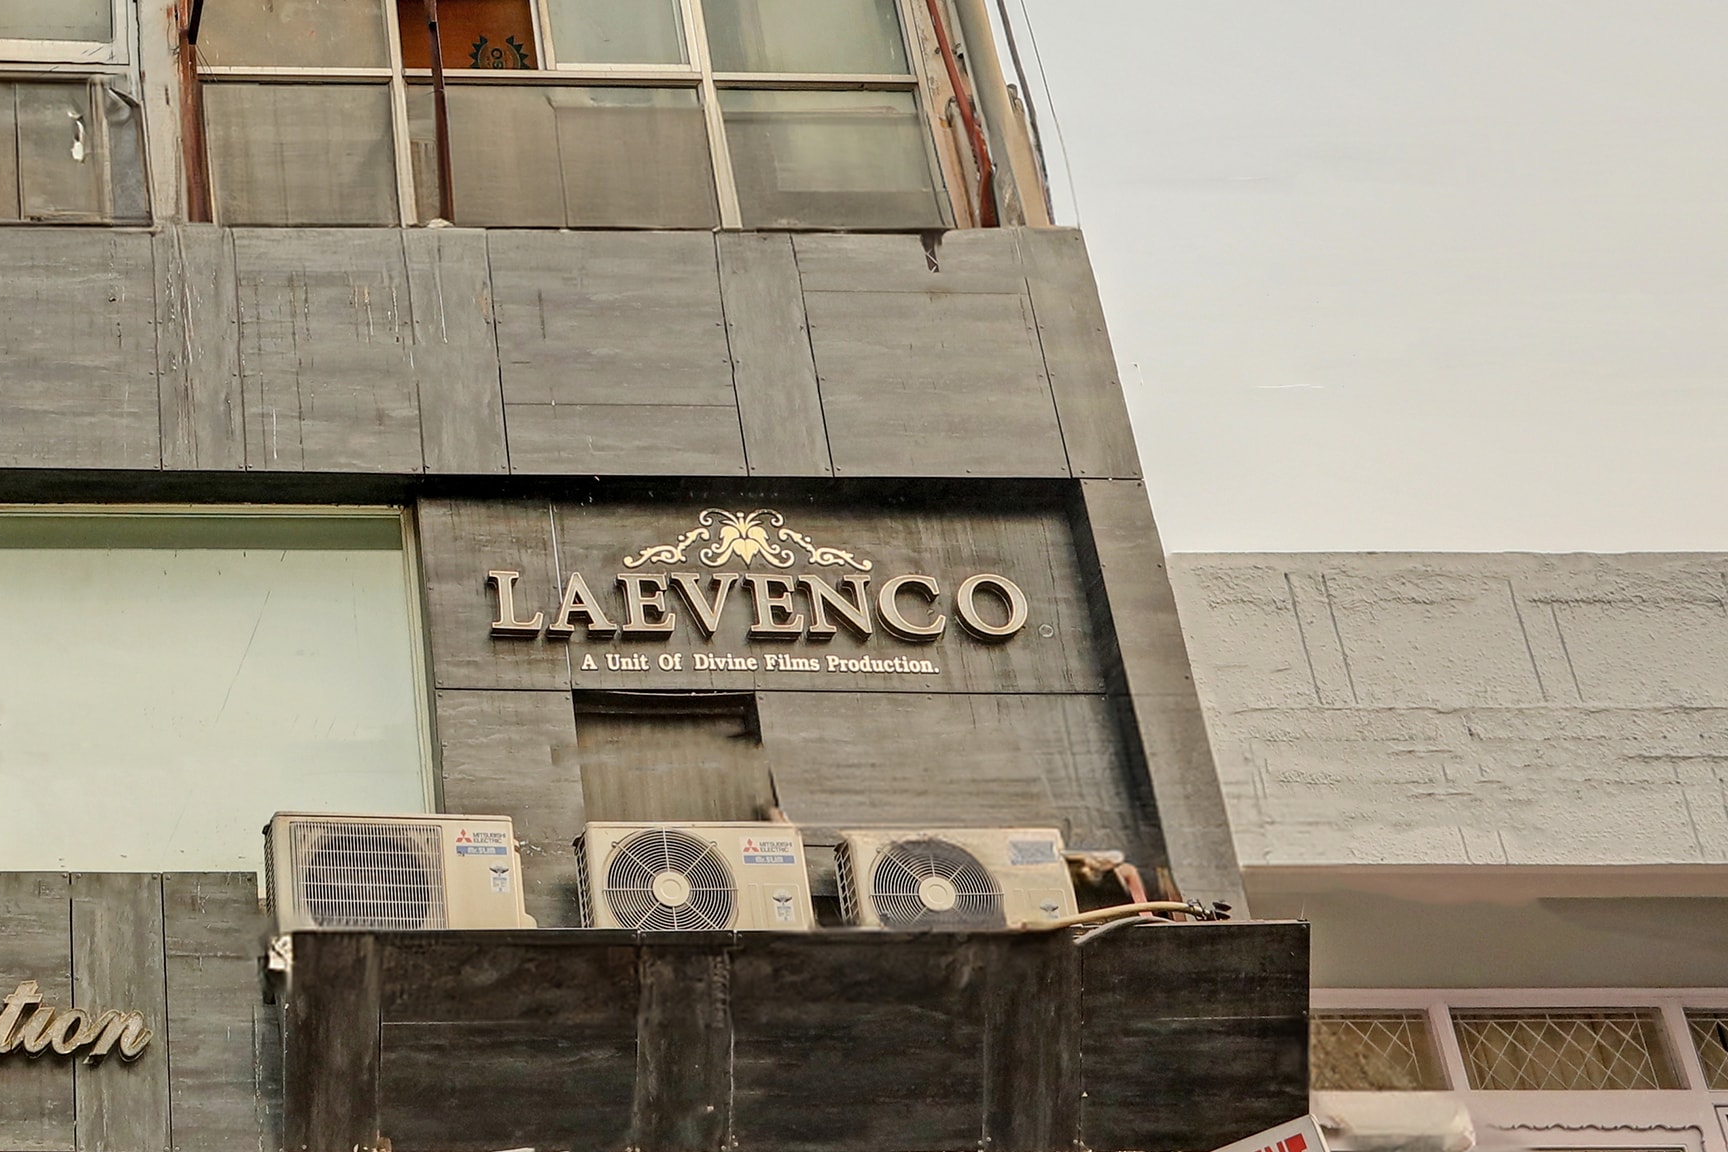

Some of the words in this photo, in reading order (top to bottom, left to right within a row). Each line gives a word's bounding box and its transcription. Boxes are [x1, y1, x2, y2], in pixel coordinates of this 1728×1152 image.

[488, 570, 1029, 642] LAEVENCO
[580, 653, 598, 671] A
[605, 653, 650, 671] Unit
[658, 653, 683, 672] Of
[693, 653, 759, 672] Divine
[764, 654, 821, 673] Films
[826, 655, 941, 675] Production.
